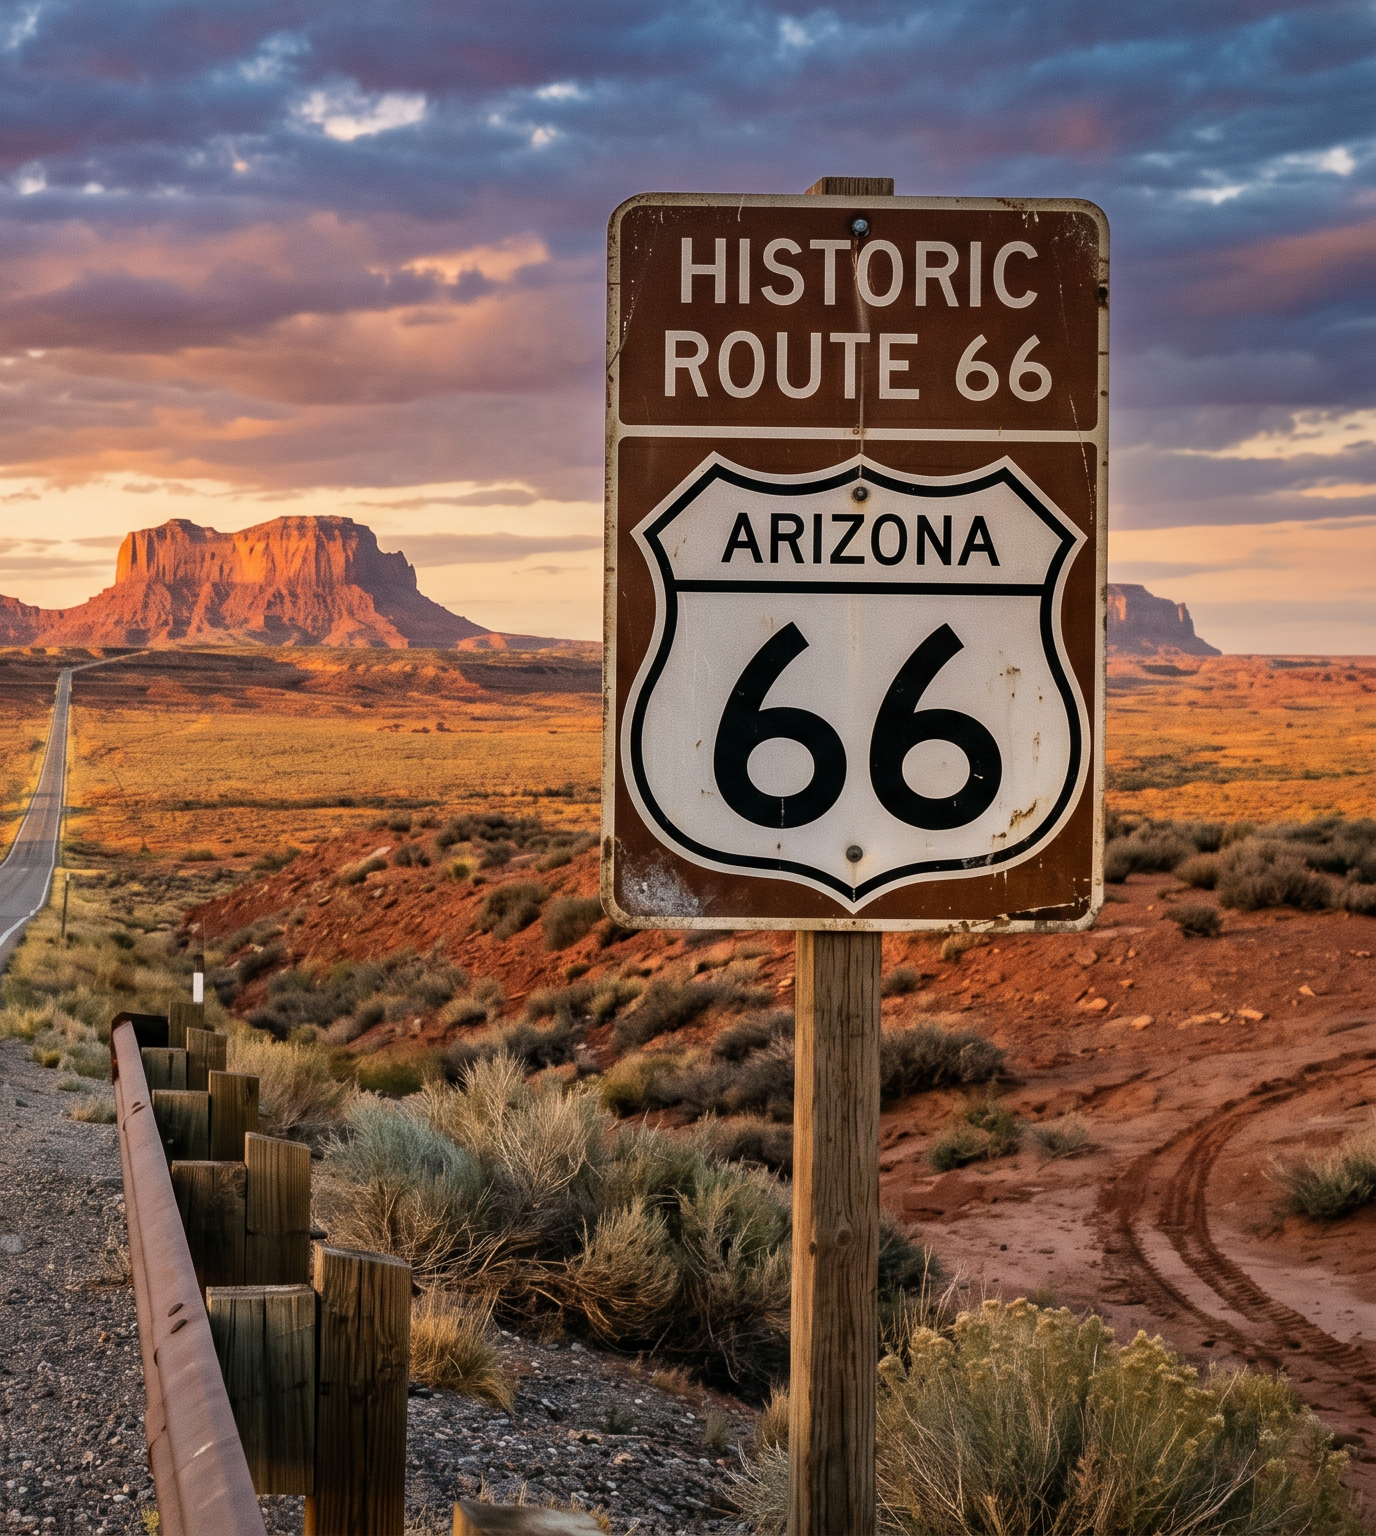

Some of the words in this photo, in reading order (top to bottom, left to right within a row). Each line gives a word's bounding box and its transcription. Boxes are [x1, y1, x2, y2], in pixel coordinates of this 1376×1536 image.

[680, 237, 1039, 309] HISTORIC
[664, 330, 920, 400] ROUTE
[955, 333, 1053, 402] 66
[721, 512, 1001, 567] ARIZONA
[713, 621, 1003, 831] 66
